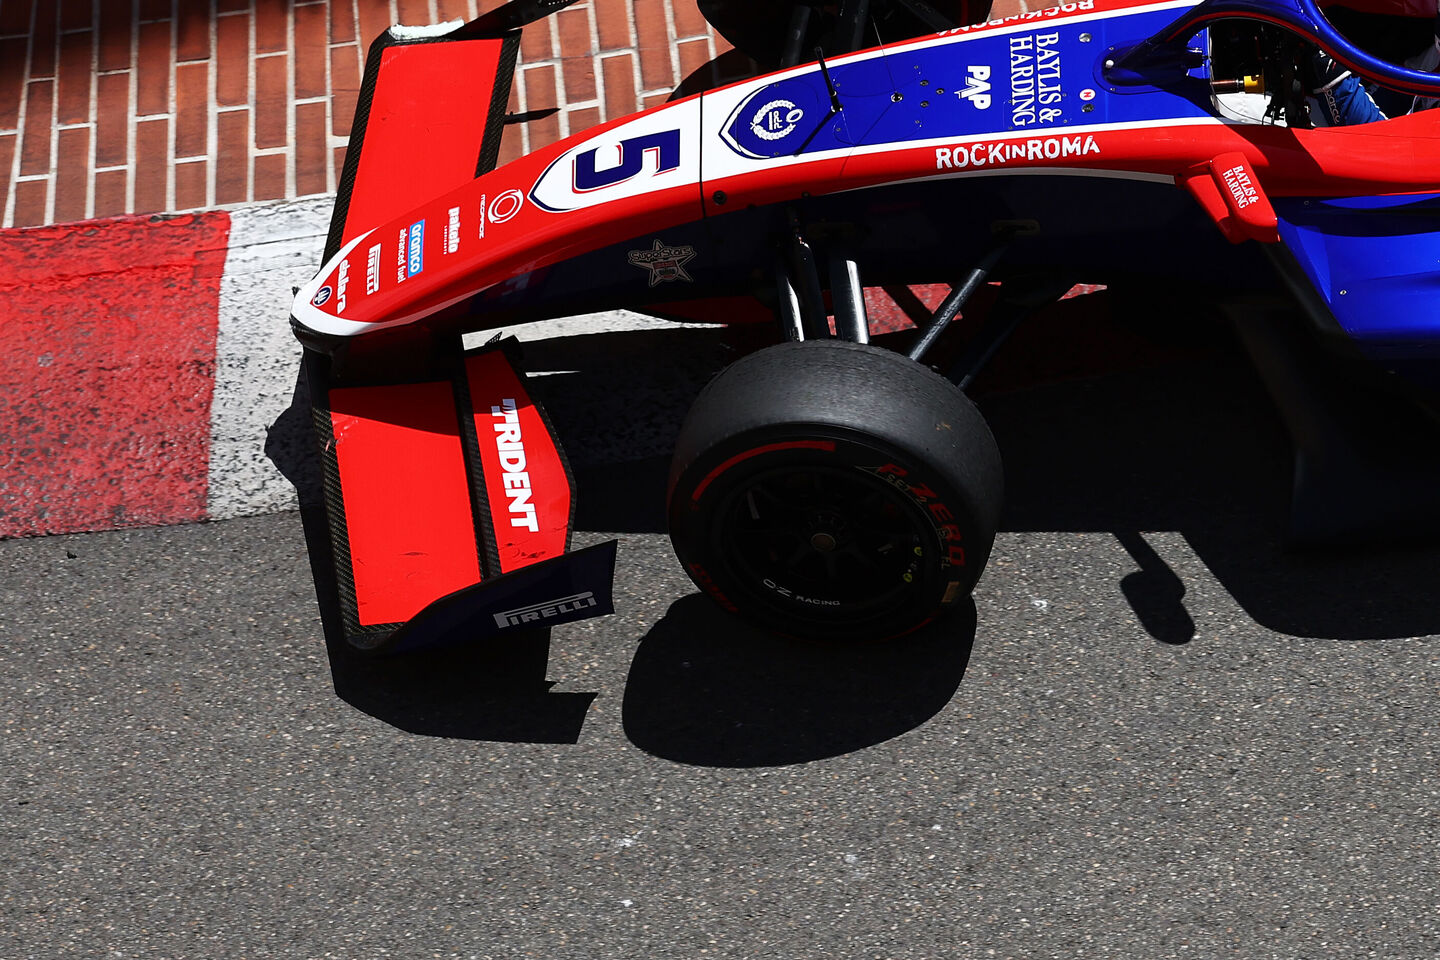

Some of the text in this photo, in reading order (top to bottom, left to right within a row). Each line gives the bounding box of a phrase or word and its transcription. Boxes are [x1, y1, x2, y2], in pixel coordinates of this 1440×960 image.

[954, 65, 992, 110] PAP
[1009, 34, 1035, 127] HARDING
[1036, 32, 1062, 124] BAYLIS &
[1325, 89, 1341, 125] parco
[573, 128, 681, 193] 5
[1232, 165, 1260, 205] BAYLIS &
[1222, 169, 1250, 209] HARDING
[410, 223, 422, 273] aramco
[448, 206, 461, 254] pakelo
[366, 242, 382, 296] PIRELLI
[397, 228, 408, 284] advanced fuel
[491, 398, 539, 533] TRIDENT
[493, 591, 599, 629] PIRELLI
[763, 578, 841, 607] OZ RACING
